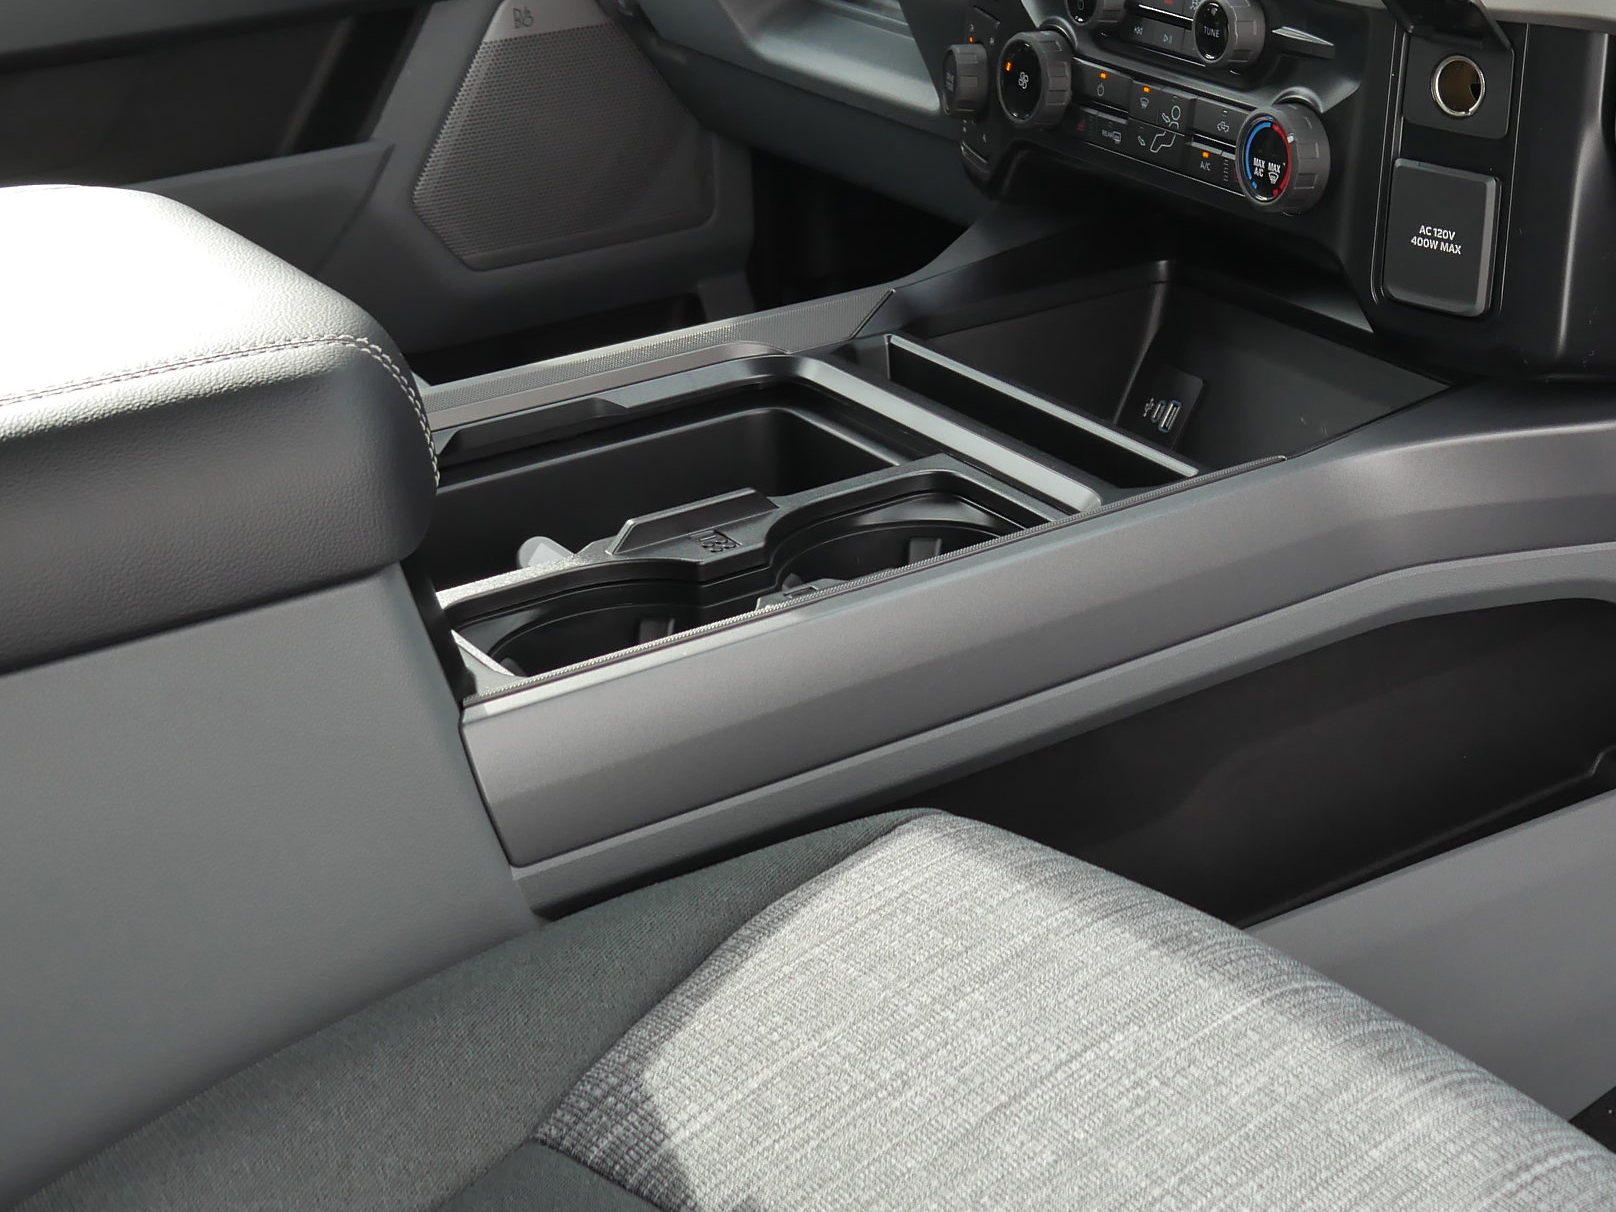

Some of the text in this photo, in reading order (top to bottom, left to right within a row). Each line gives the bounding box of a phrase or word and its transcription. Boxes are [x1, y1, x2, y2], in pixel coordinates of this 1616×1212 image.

[1203, 25, 1220, 38] TUNE
[1102, 129, 1114, 139] REAR
[1200, 161, 1211, 172] A/C
[1253, 157, 1266, 170] MAX
[1267, 161, 1281, 174] MAX
[1253, 167, 1264, 178] A/C
[1419, 225, 1456, 241] AC 120V
[1411, 236, 1461, 255] 400W MAX
